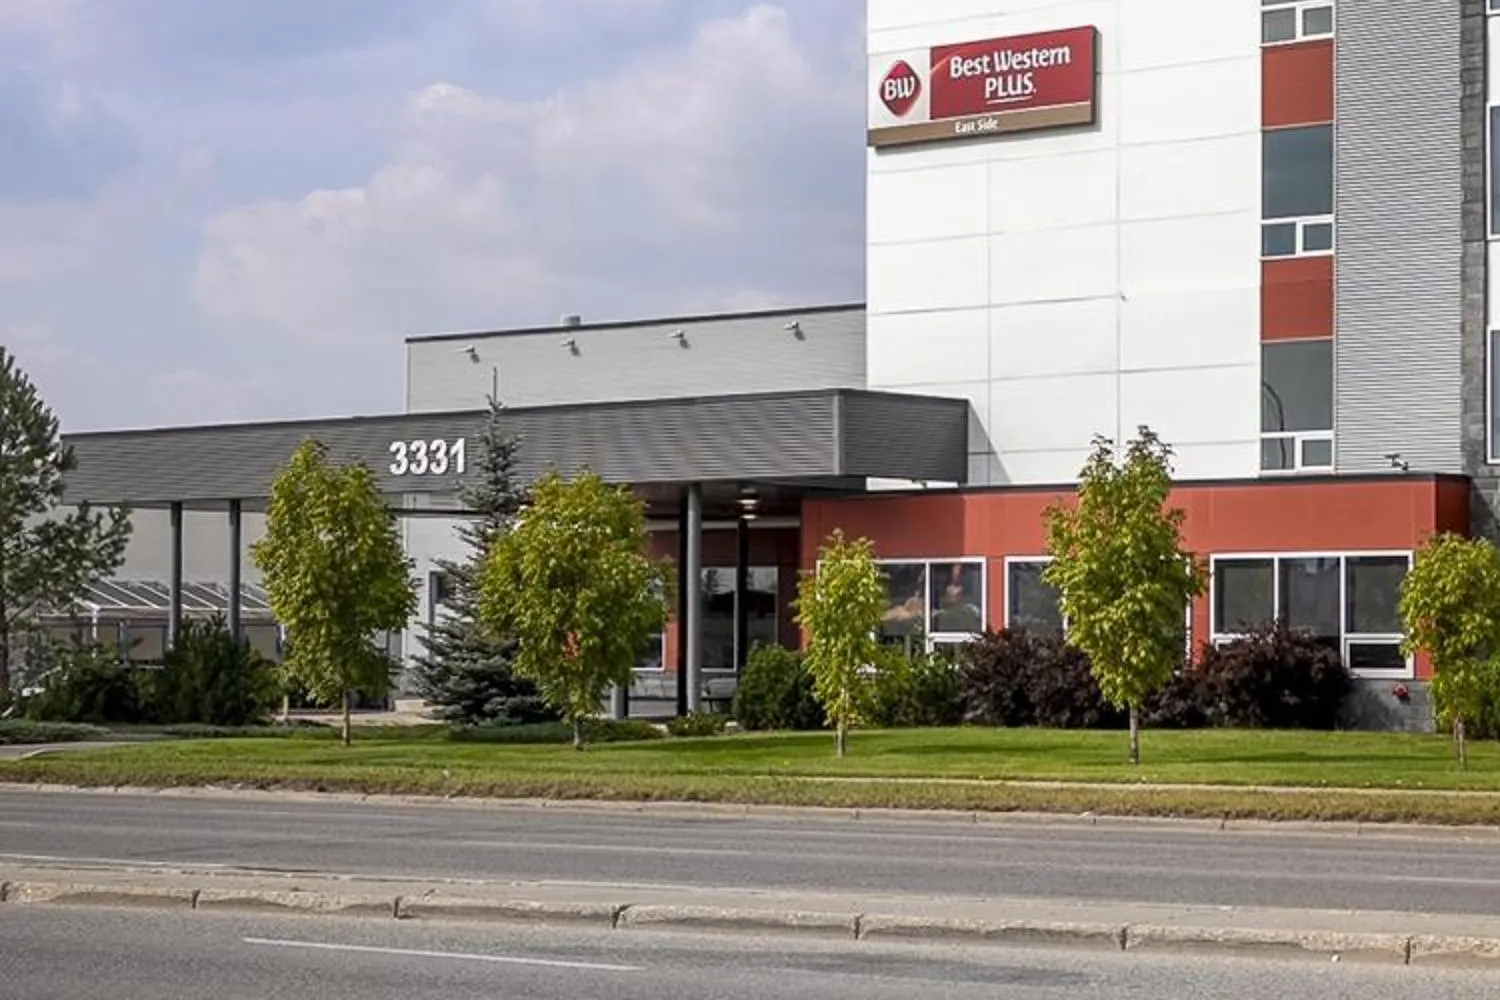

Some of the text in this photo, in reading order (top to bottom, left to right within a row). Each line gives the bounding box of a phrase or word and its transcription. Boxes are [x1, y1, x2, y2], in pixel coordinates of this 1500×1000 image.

[950, 46, 1070, 78] Best Western
[884, 76, 915, 100] BW
[955, 117, 998, 133] East Side
[389, 438, 465, 475] 3331
